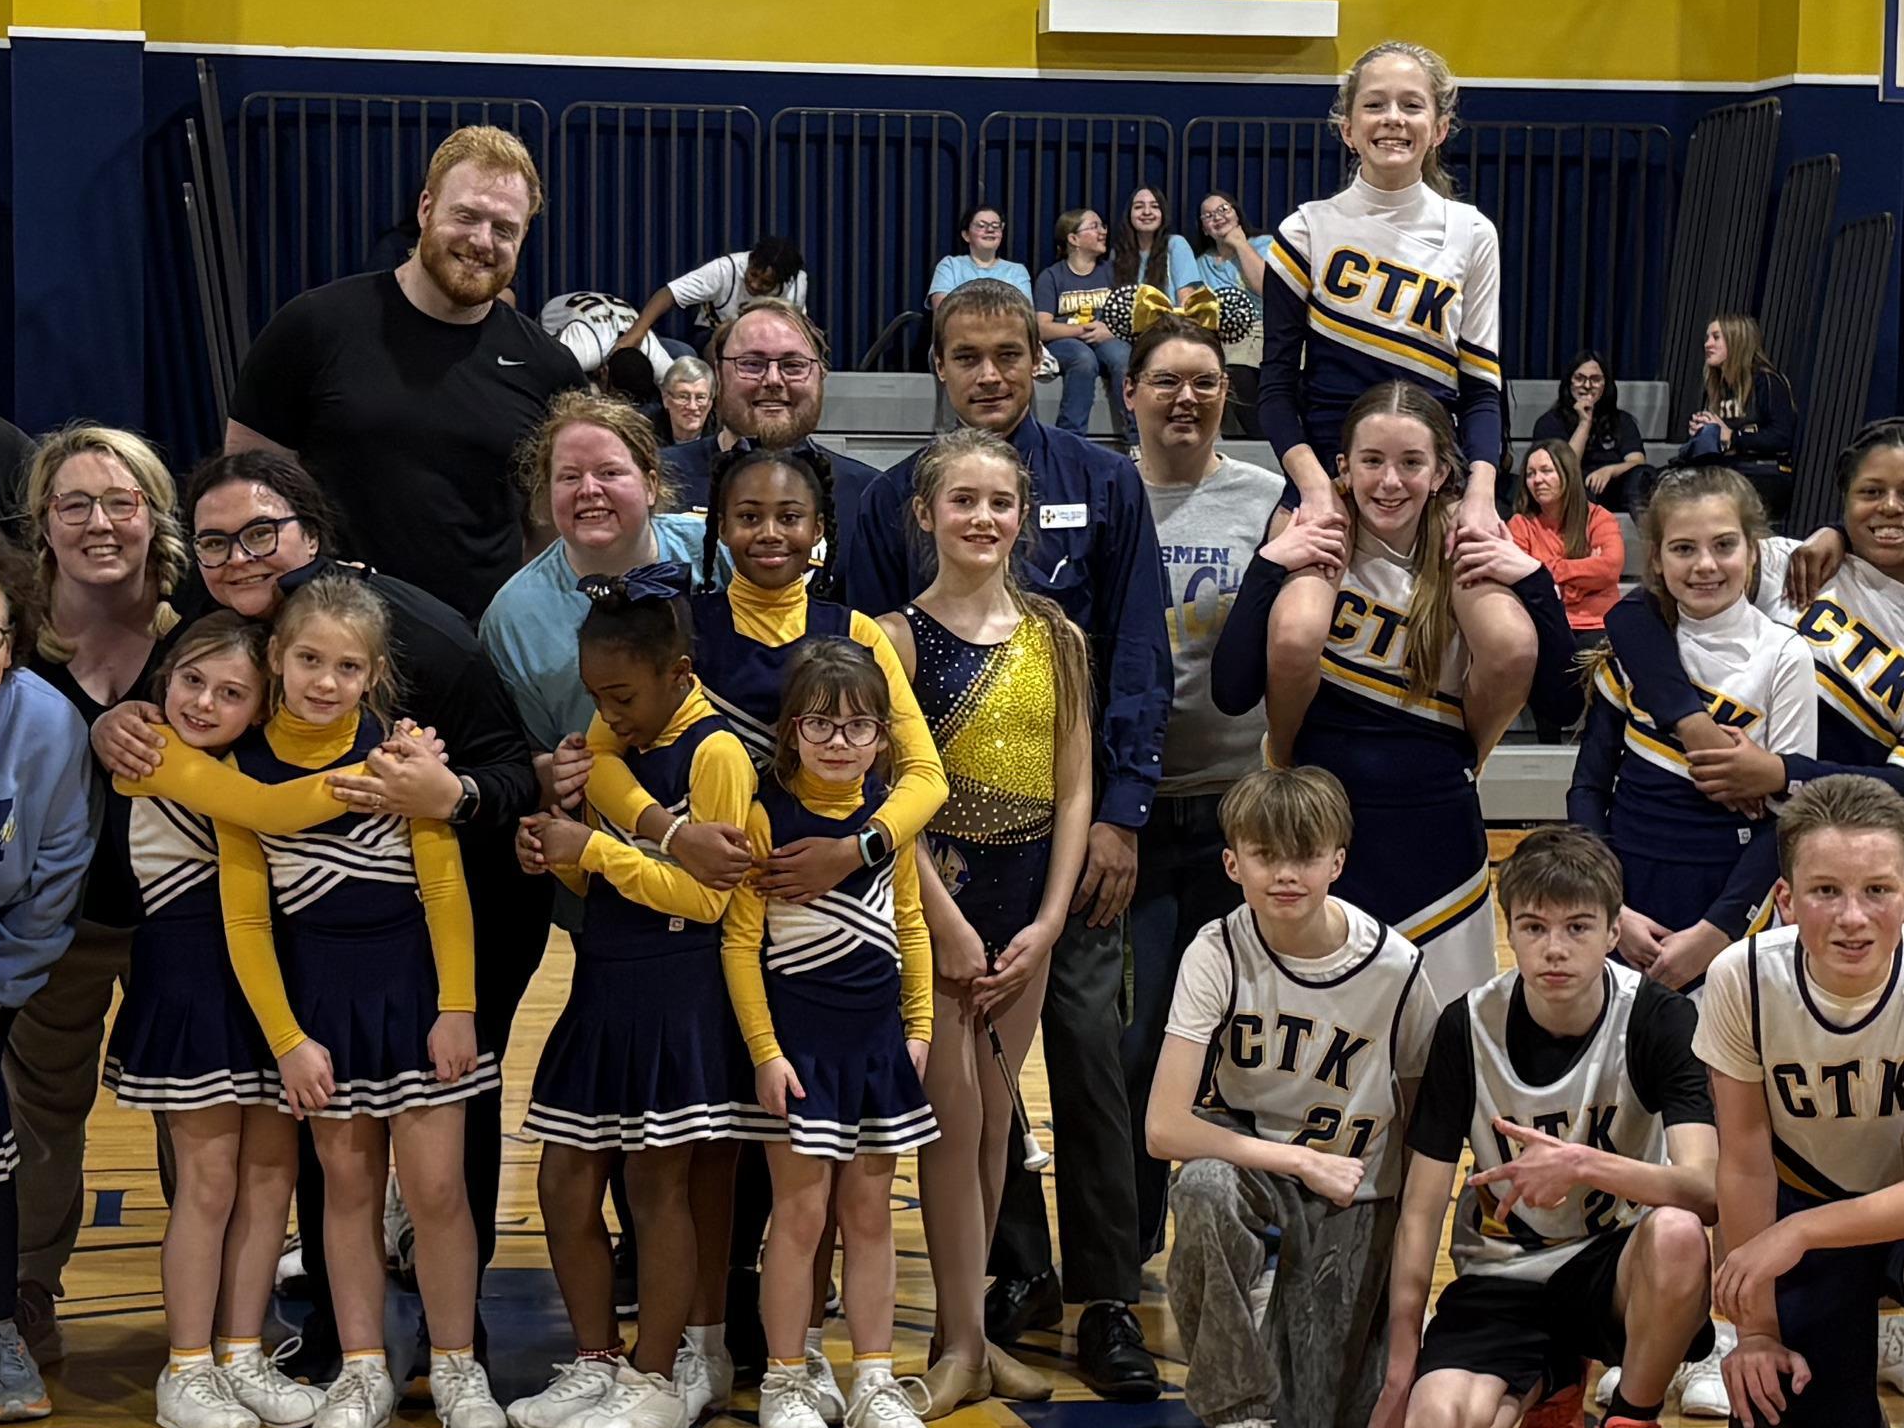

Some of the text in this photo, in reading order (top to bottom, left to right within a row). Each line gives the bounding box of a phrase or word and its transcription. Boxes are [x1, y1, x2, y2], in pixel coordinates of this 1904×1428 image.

[1322, 247, 1459, 337] CTK
[1160, 546, 1229, 564] SMEN
[1327, 588, 1414, 669] CT
[1230, 1010, 1373, 1092] CTK
[1292, 1104, 1377, 1158] 21
